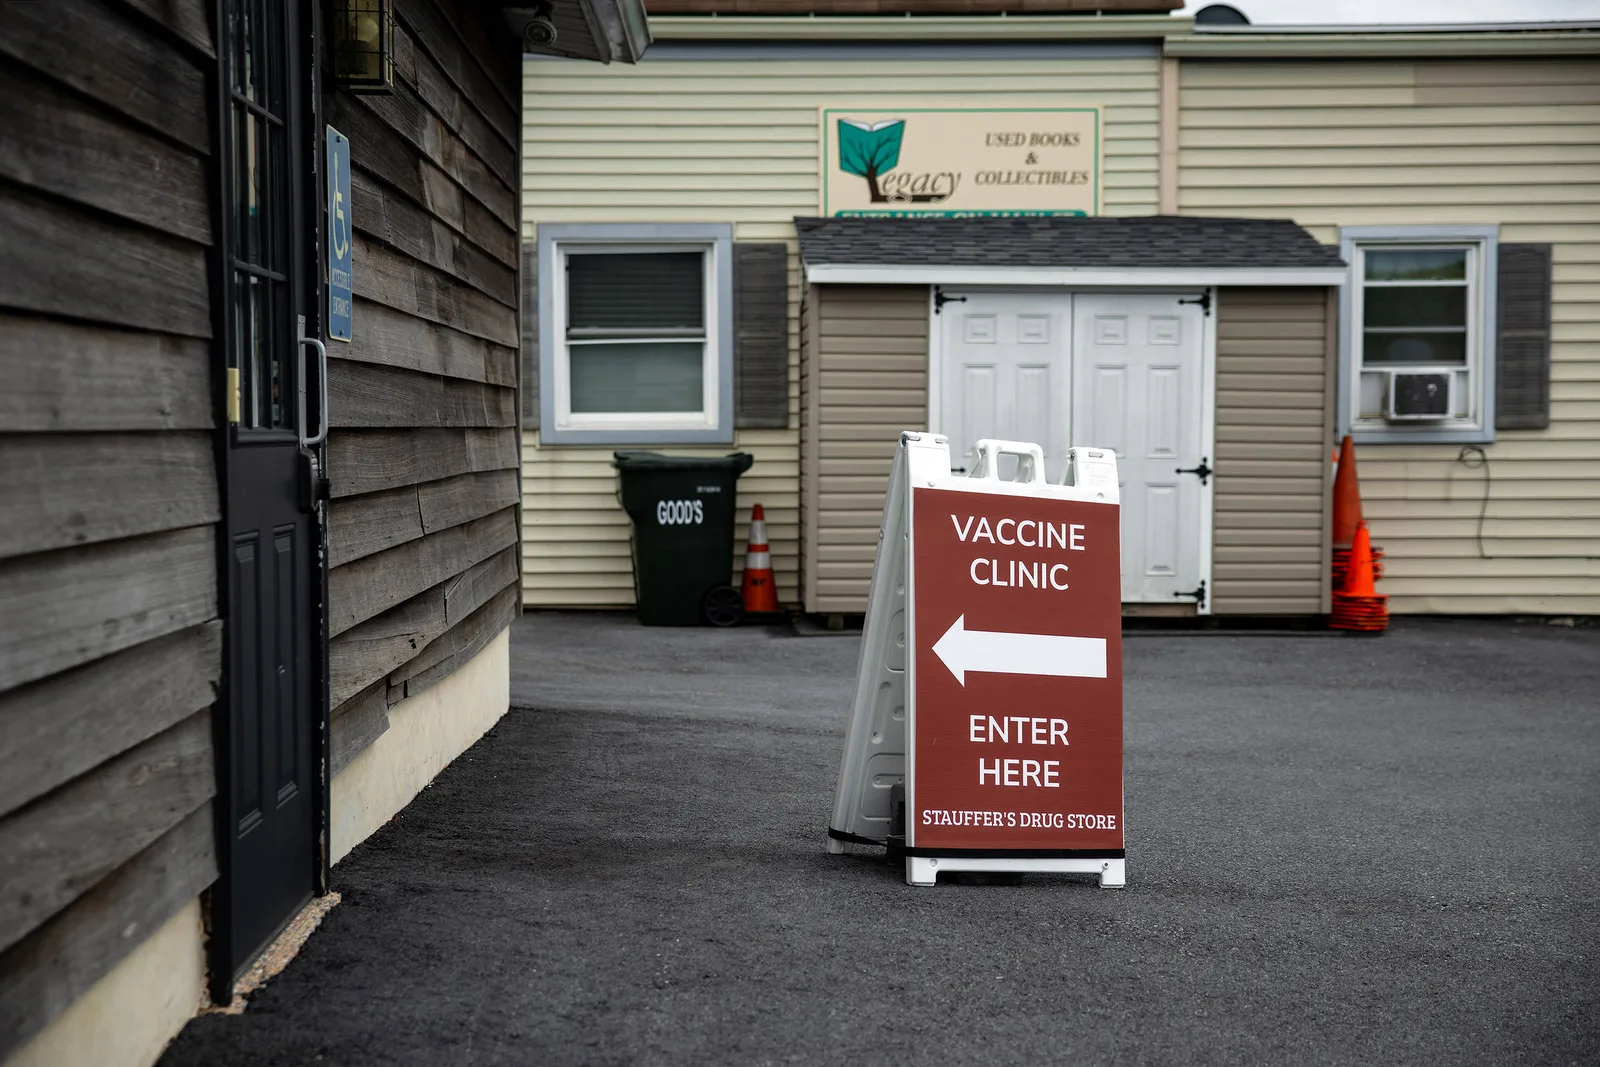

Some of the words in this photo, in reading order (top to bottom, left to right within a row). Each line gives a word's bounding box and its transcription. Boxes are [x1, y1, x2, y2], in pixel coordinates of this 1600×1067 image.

[985, 132, 1026, 147] USED
[1028, 132, 1080, 147] BOOKS
[1025, 152, 1038, 165] &
[974, 170, 1089, 186] COLLECTIBLES
[657, 500, 704, 525] GOOD'S
[951, 514, 1086, 551] VACCINE
[970, 557, 1069, 591] CLINIC
[969, 714, 1070, 746] ENTER
[979, 757, 1060, 788] HERE
[922, 809, 1017, 828] STAUFFER'S
[1019, 812, 1064, 829] DRUG
[1067, 813, 1116, 830] STORE
